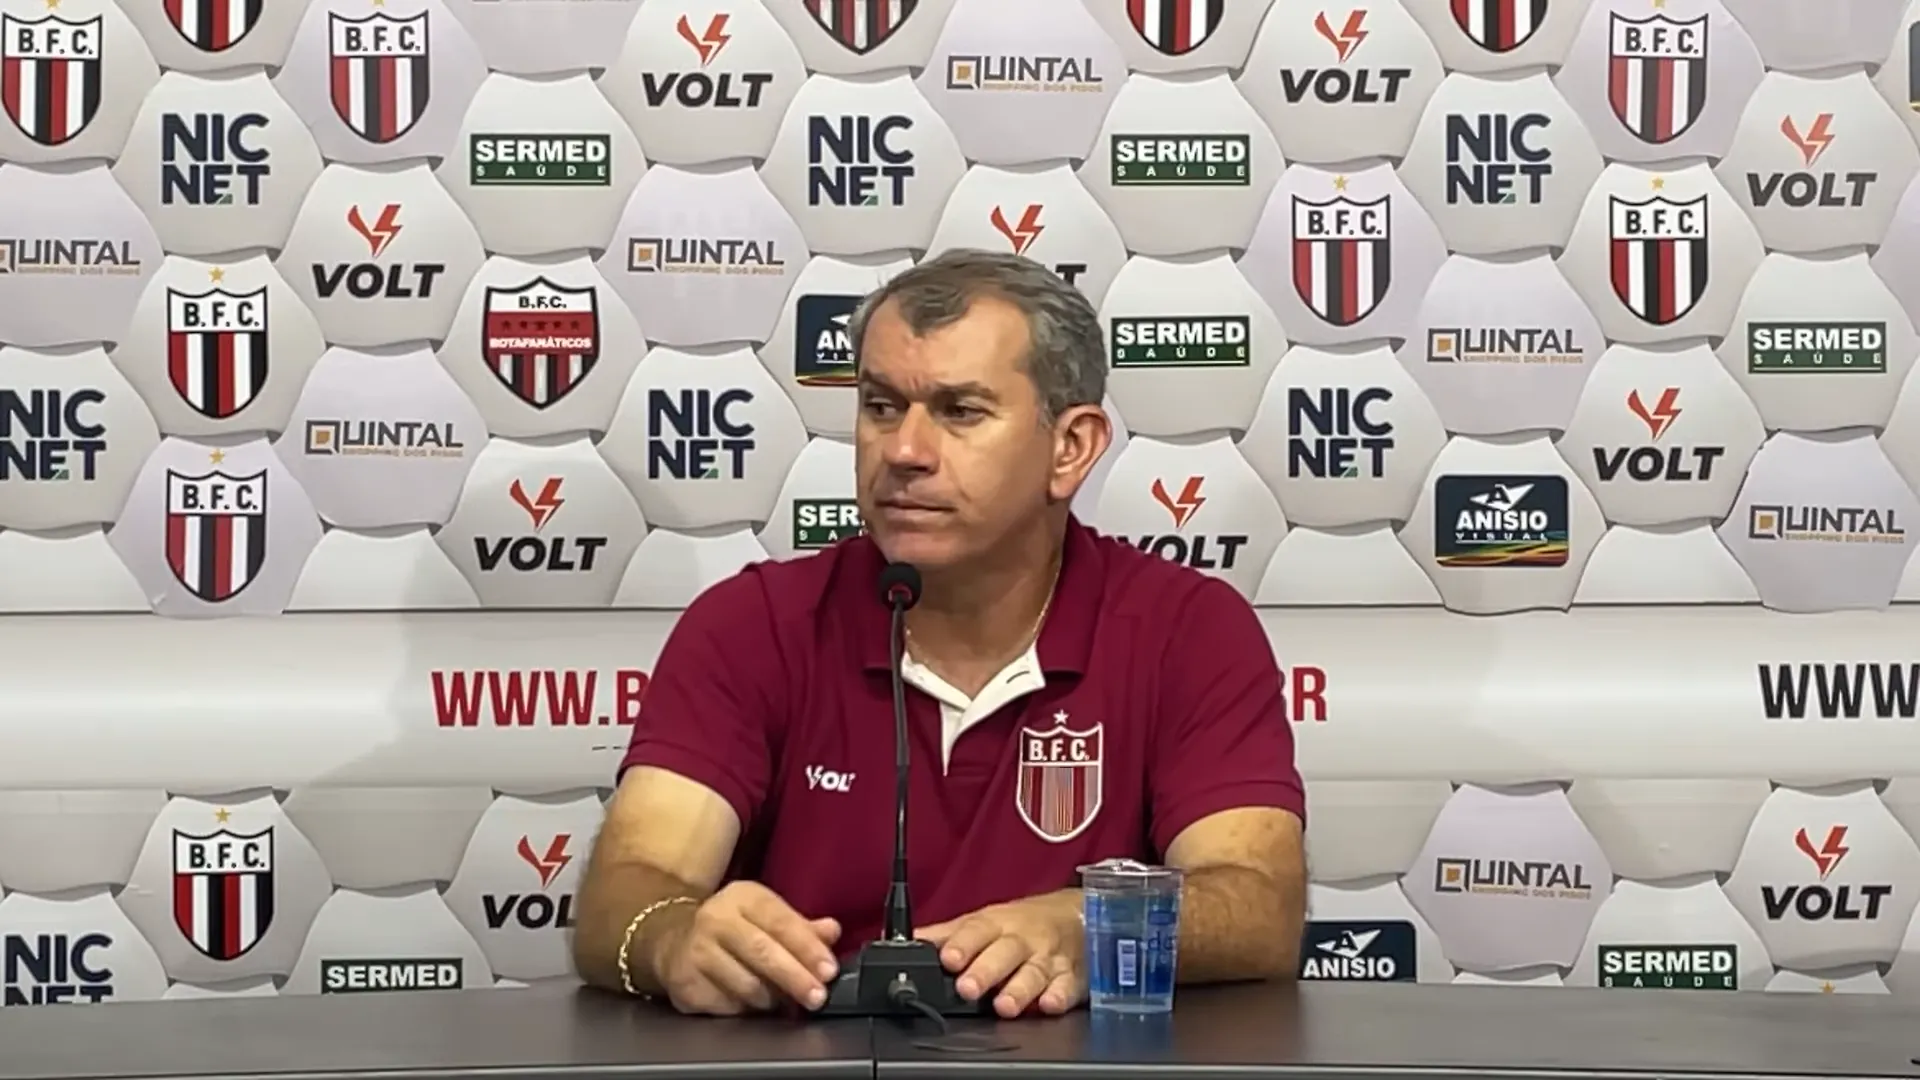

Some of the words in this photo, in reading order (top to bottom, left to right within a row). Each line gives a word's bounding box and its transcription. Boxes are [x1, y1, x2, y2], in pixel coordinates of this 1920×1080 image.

[641, 72, 774, 108] VOLT
[946, 55, 1103, 90] QUINTAL
[1279, 68, 1412, 104] VOLT
[161, 113, 270, 163] NIC
[475, 139, 606, 162] SERMED
[808, 115, 914, 165] NIC
[1116, 140, 1246, 163] SERMED
[1446, 113, 1552, 163] NIC
[161, 164, 271, 205] NET
[808, 165, 915, 206] NET
[1446, 163, 1553, 205] NET
[1746, 172, 1878, 208] VOLT
[627, 238, 784, 272] QUINTAL
[312, 263, 445, 299] VOLT
[1116, 321, 1246, 346] SERMED
[1427, 328, 1583, 363] QUINTAL
[1753, 328, 1882, 351] SERMED
[0, 389, 106, 438] NIC
[648, 388, 755, 438] NIC
[1288, 387, 1394, 437] NIC
[305, 419, 463, 455] QUINTAL
[0, 440, 106, 480] NET
[648, 439, 755, 480] NET
[1288, 437, 1395, 478] NET
[1592, 446, 1725, 482] VOLT
[798, 504, 866, 527] SER
[1456, 510, 1547, 531] ANISIO
[1748, 505, 1905, 540] QUINTAL
[473, 536, 608, 572] VOLT
[1758, 663, 1920, 719] WWW
[1435, 857, 1592, 895] QUINTAL
[1761, 885, 1893, 921] VOLT
[4, 933, 114, 984] NIC
[1303, 956, 1396, 979] ANISIO
[1603, 950, 1733, 974] SERMED
[326, 964, 459, 990] SERMED
